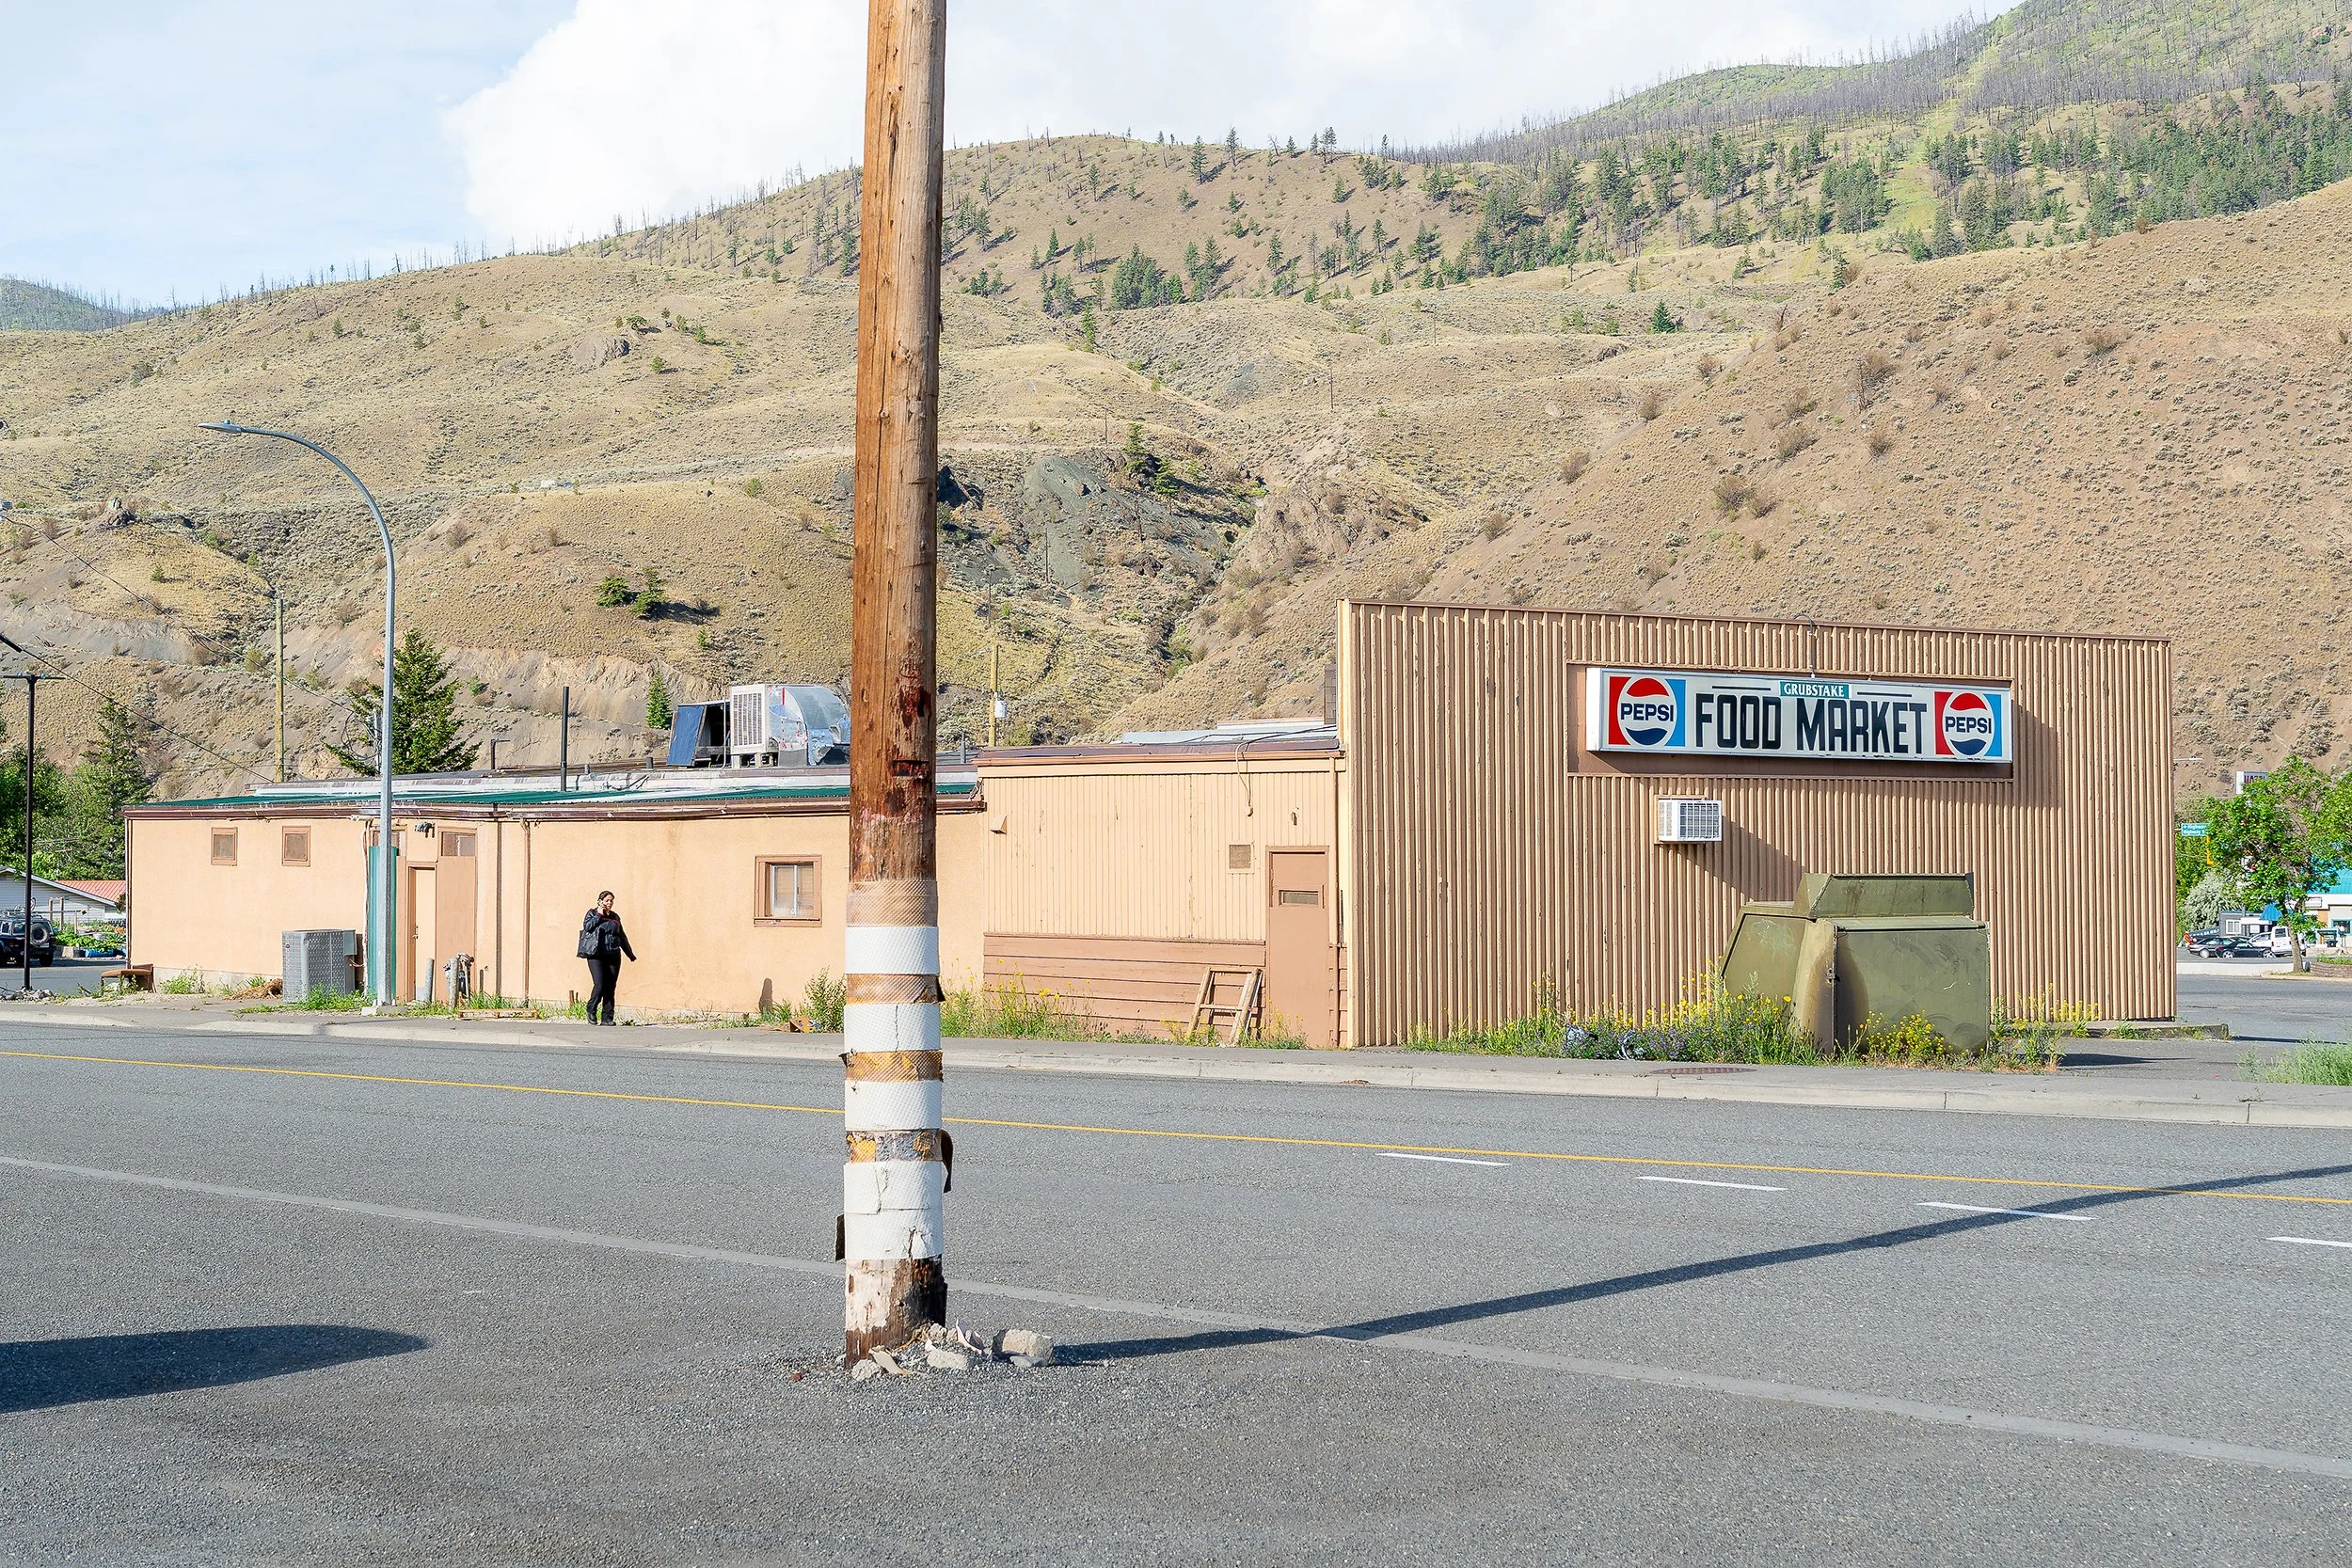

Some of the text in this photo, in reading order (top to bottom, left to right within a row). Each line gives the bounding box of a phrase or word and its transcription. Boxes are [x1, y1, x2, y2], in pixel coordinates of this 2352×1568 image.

[1783, 682, 1845, 697] GRUBSTAKE
[1620, 703, 1675, 722] PEPSI
[1695, 692, 1928, 754] FOOD MARKET
[1945, 716, 1993, 735] PEPSI
